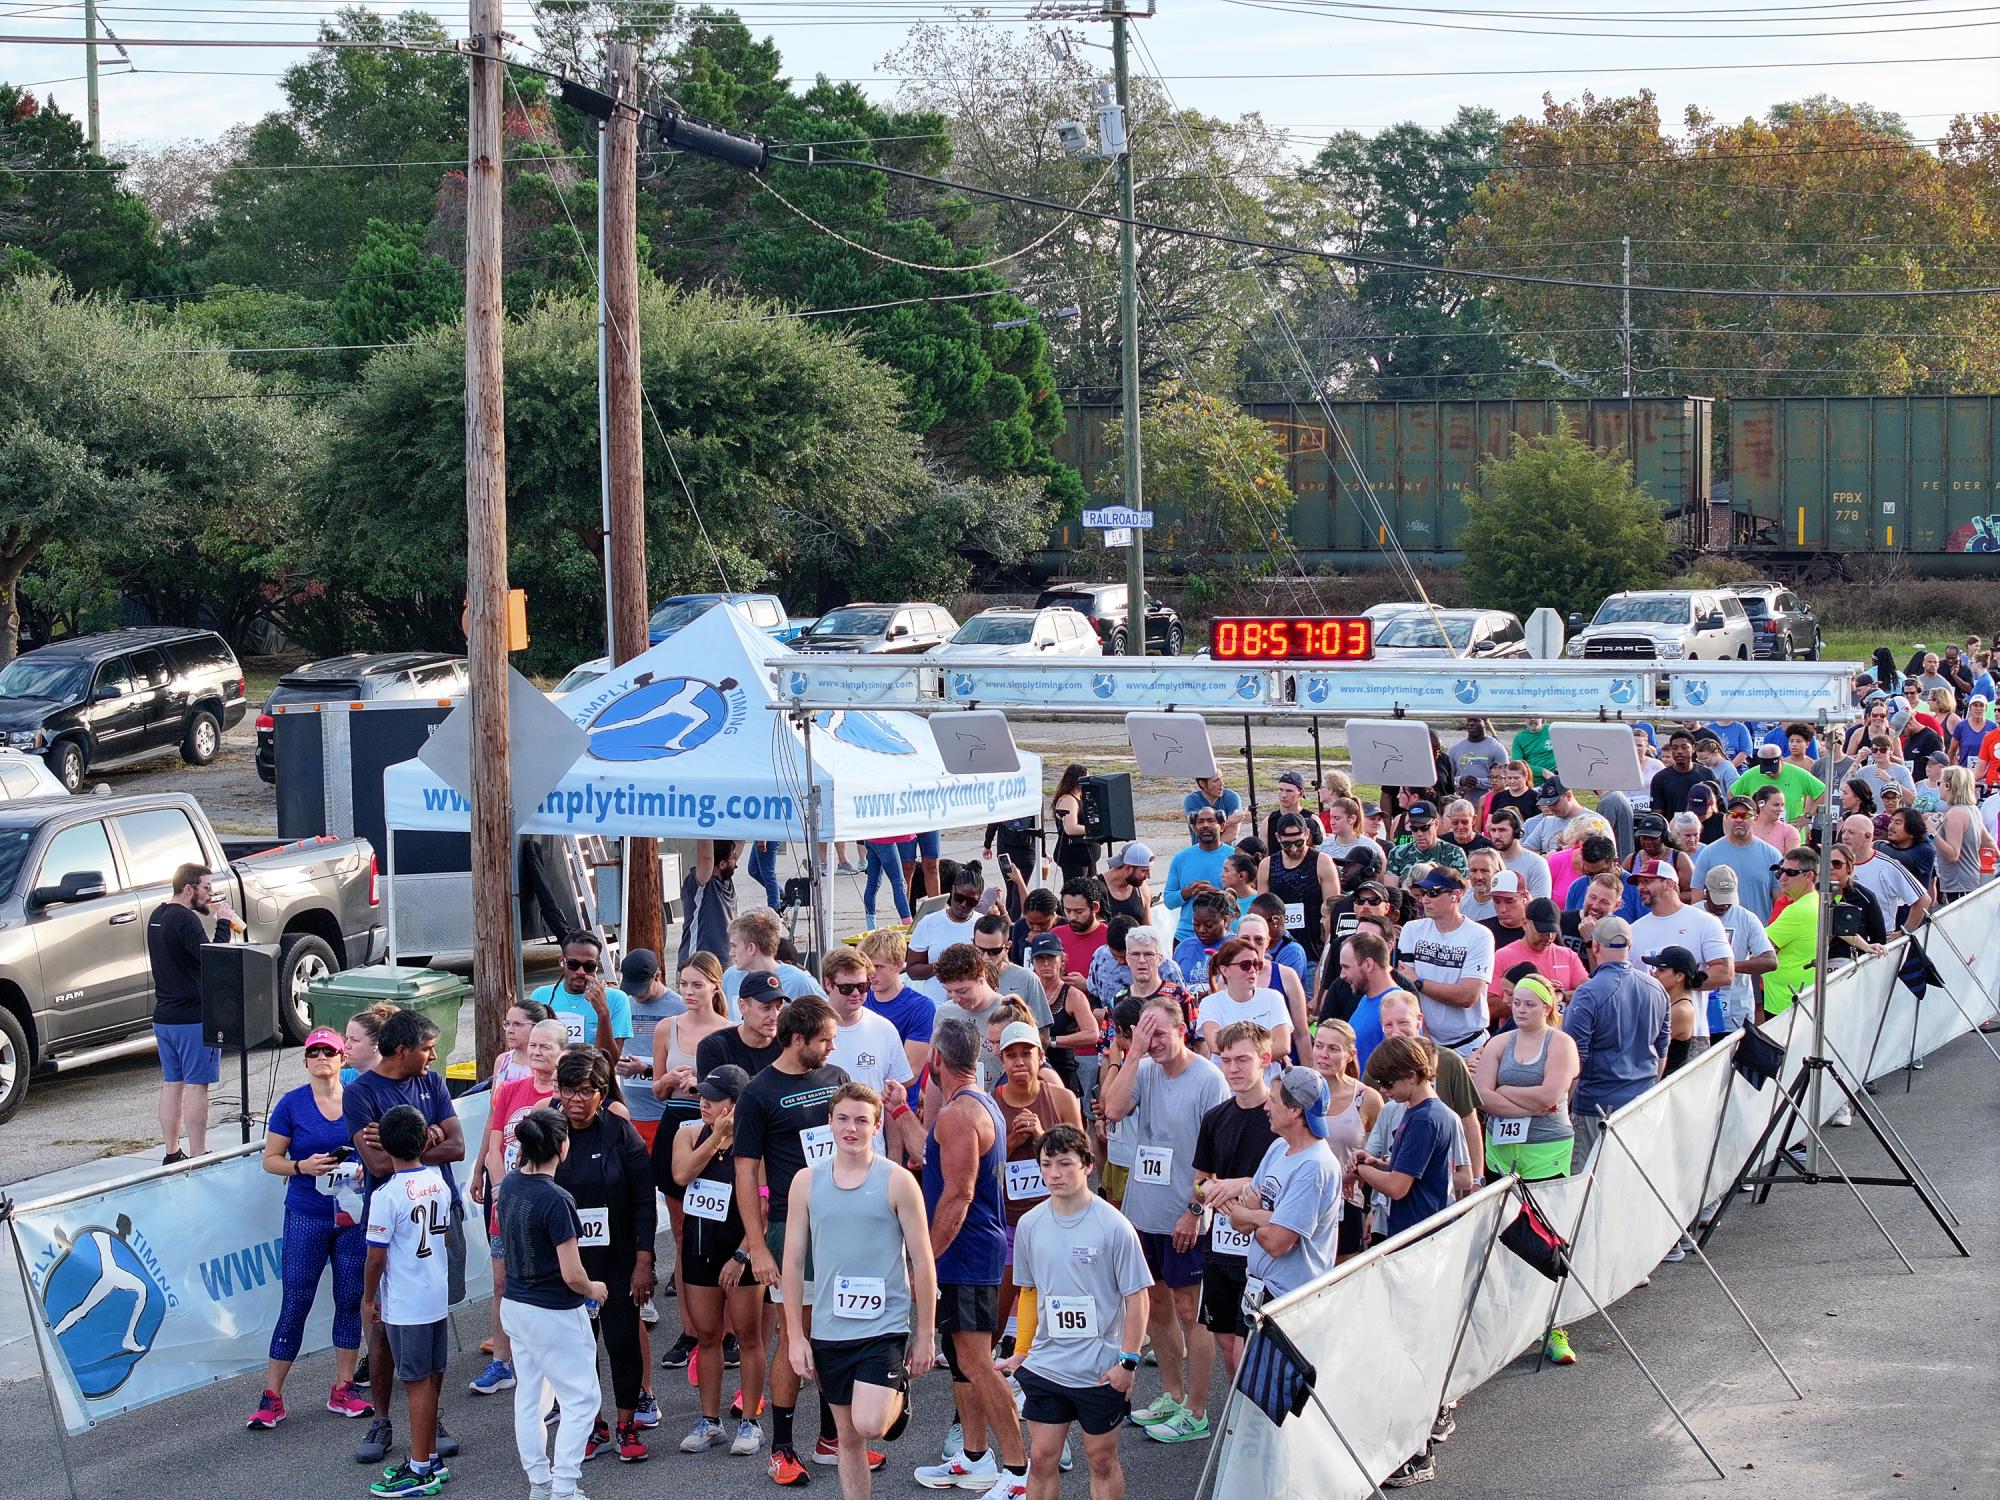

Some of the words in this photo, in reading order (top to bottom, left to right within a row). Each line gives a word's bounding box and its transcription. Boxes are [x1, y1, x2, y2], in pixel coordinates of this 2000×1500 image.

[1833, 492, 1863, 503] FPBX
[1089, 512, 1139, 525] RAILROAD
[1835, 510, 1860, 521] 778
[1218, 622, 1366, 656] 08:57:03
[818, 679, 914, 692] www.simplytiming.com
[984, 679, 1083, 693] www.simplytiming.com
[1125, 680, 1227, 693] www.simplytiming.com
[1340, 684, 1444, 697] www.simplytiming.com
[1489, 686, 1599, 698] www.simplytiming.com
[1720, 687, 1831, 699] www.simplytiming.com
[573, 680, 629, 726] SIMPLY
[723, 688, 747, 736] TIMING
[853, 775, 1027, 820] www.simplytiming.com
[55, 990, 84, 1003] RAM
[1500, 1122, 1521, 1138] 743
[1142, 1159, 1162, 1177] 174
[688, 1192, 726, 1212] 1905
[410, 1199, 450, 1259] 24
[581, 1220, 604, 1239] 02
[1215, 1230, 1251, 1247] 1769
[132, 1228, 181, 1309] TIMING
[837, 1293, 882, 1311] 1779
[1055, 1310, 1087, 1330] 195
